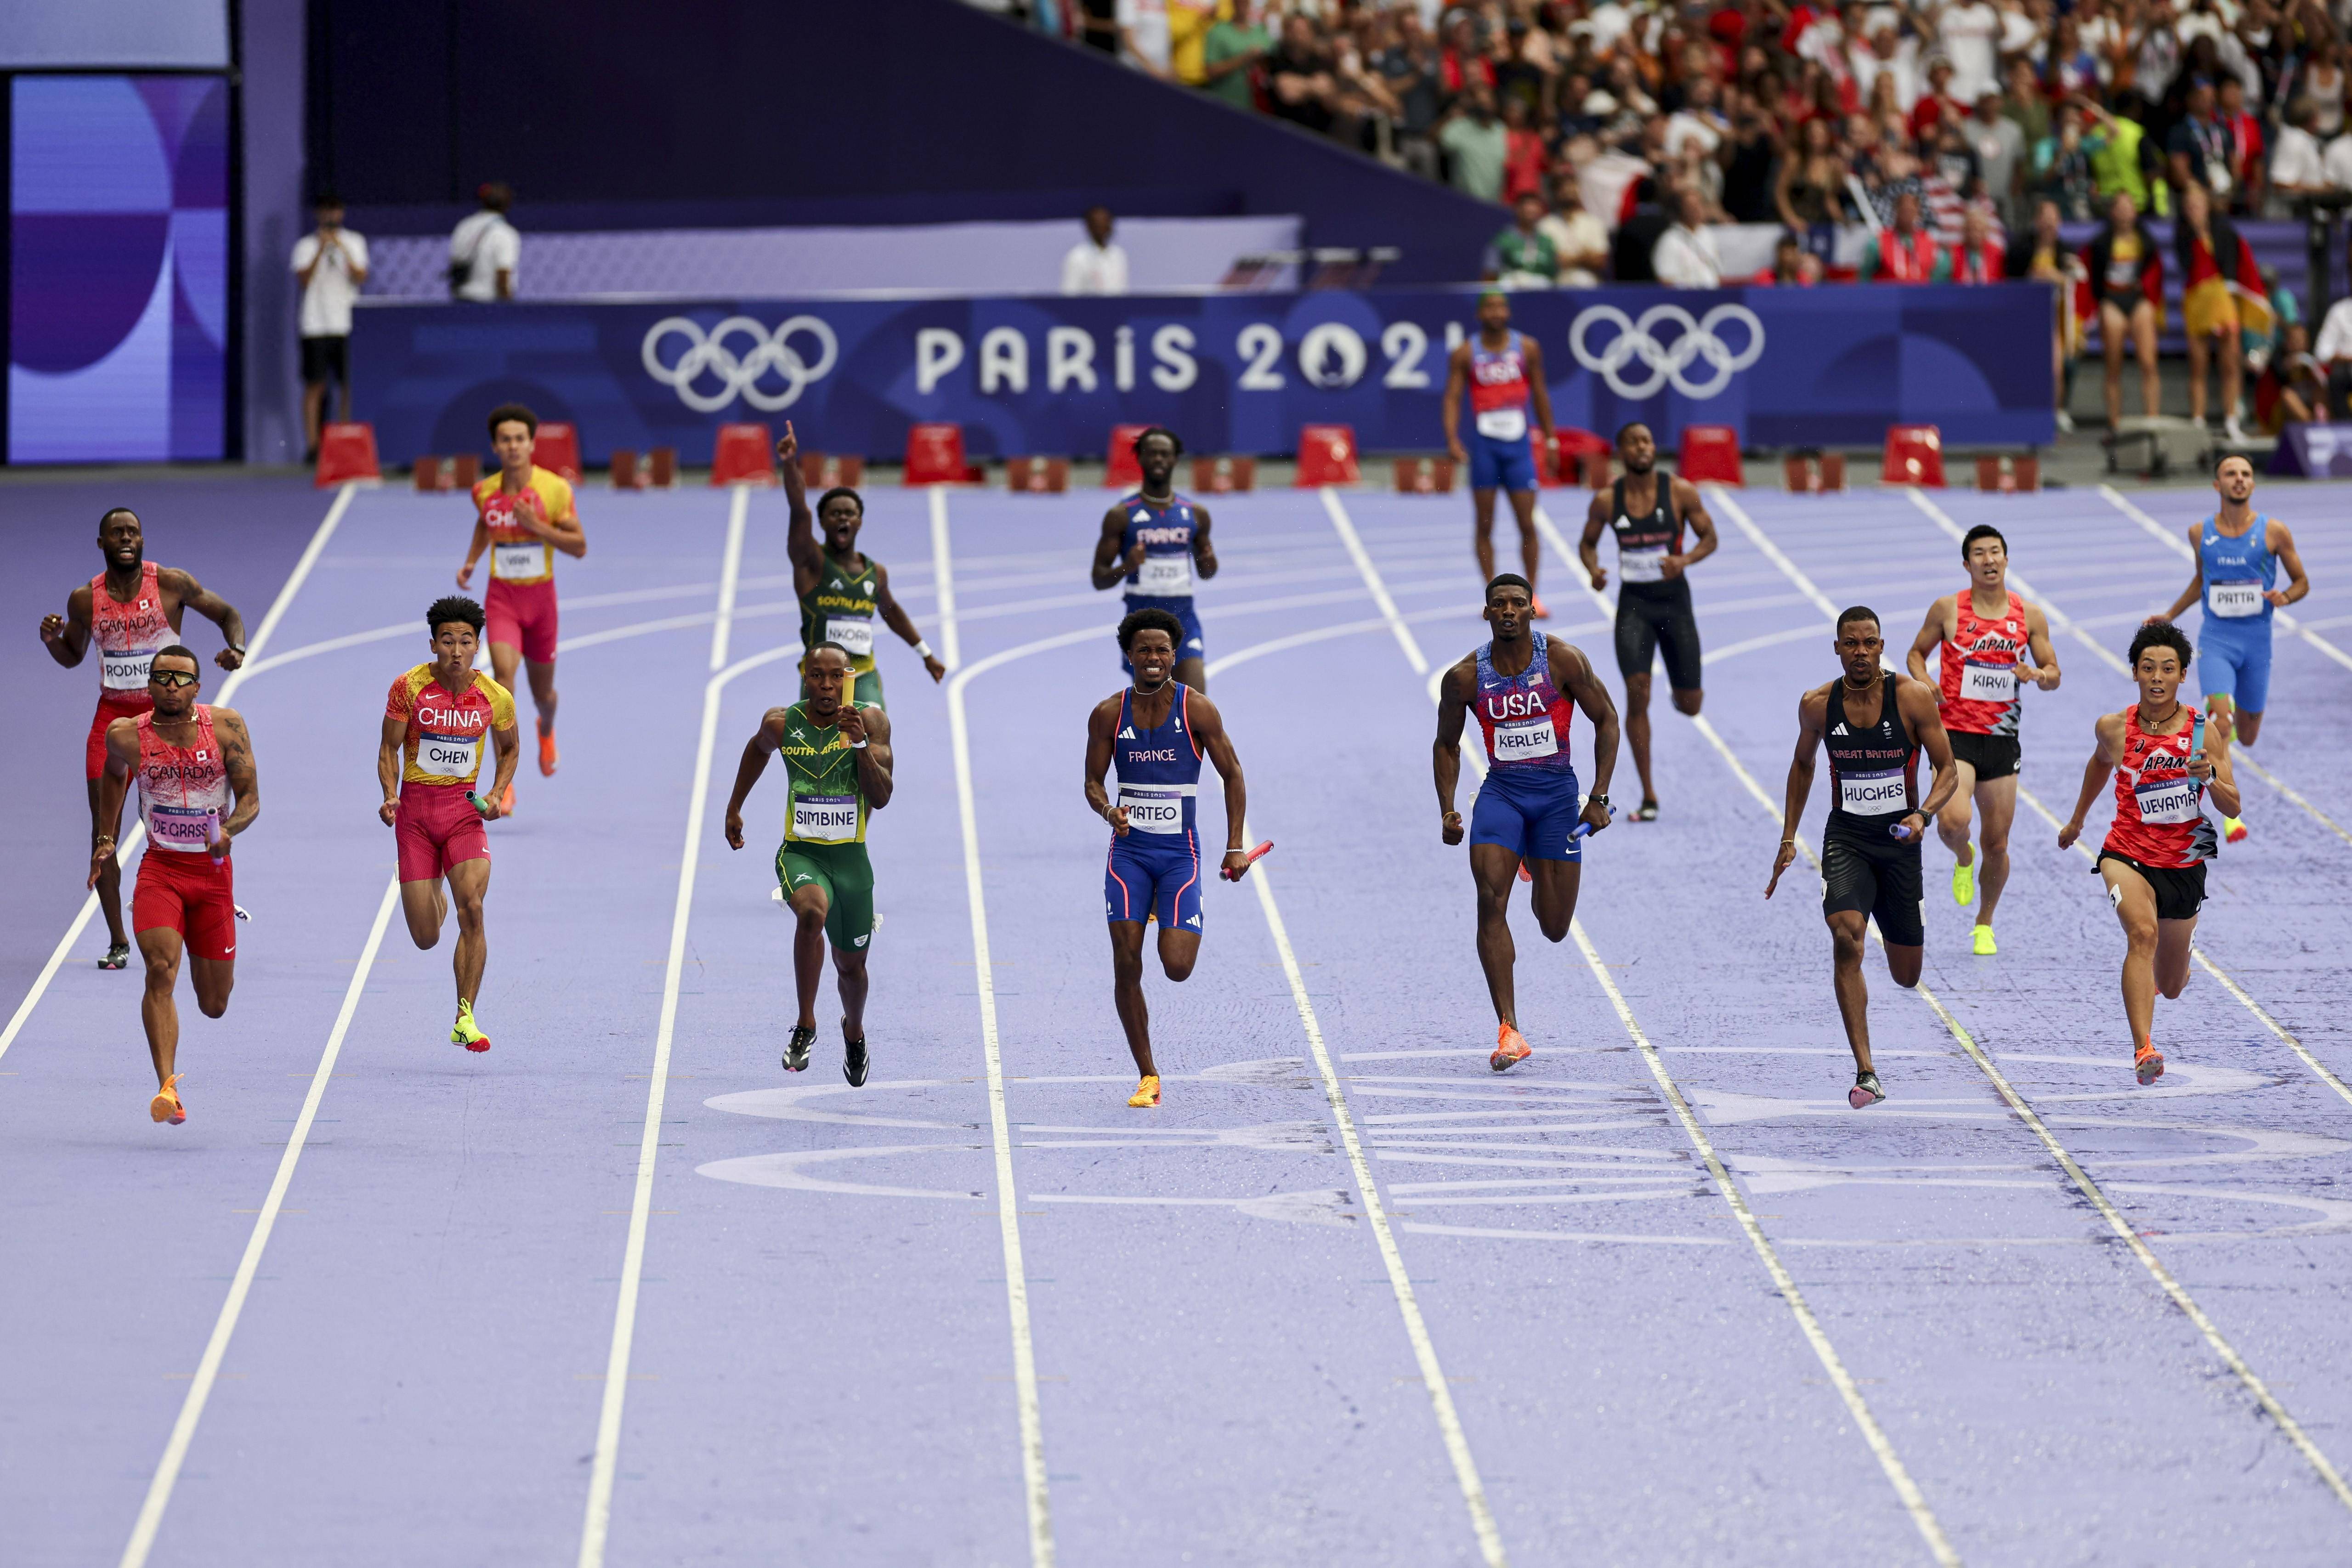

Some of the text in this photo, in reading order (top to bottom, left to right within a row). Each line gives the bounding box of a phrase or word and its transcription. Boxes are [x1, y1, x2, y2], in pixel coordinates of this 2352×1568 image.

[916, 321, 1464, 394] PARIS 202
[2217, 556, 2247, 566] ITALIA
[816, 595, 853, 609] SOUTH
[2217, 591, 2255, 604] PATTA
[99, 615, 157, 632] CANADA
[1969, 639, 2017, 651] JAPAN
[106, 662, 151, 677] RODNE
[1973, 674, 2009, 688] KIRYU
[1488, 691, 1547, 719] USA
[419, 707, 482, 727] CHINA
[1499, 729, 1550, 748] KERLEY
[430, 748, 469, 764] CHEN
[782, 747, 815, 756] SOUTH
[1128, 748, 1177, 763] FRANCE
[1832, 747, 1904, 759] GREAT BRITAIN
[148, 765, 215, 780] CANADA
[1845, 783, 1904, 801] HUGHES
[2140, 792, 2196, 815] UEYAMA
[795, 810, 855, 826] SIMBINE
[1124, 804, 1177, 821] MATEO
[153, 819, 208, 838] DE GRASS
